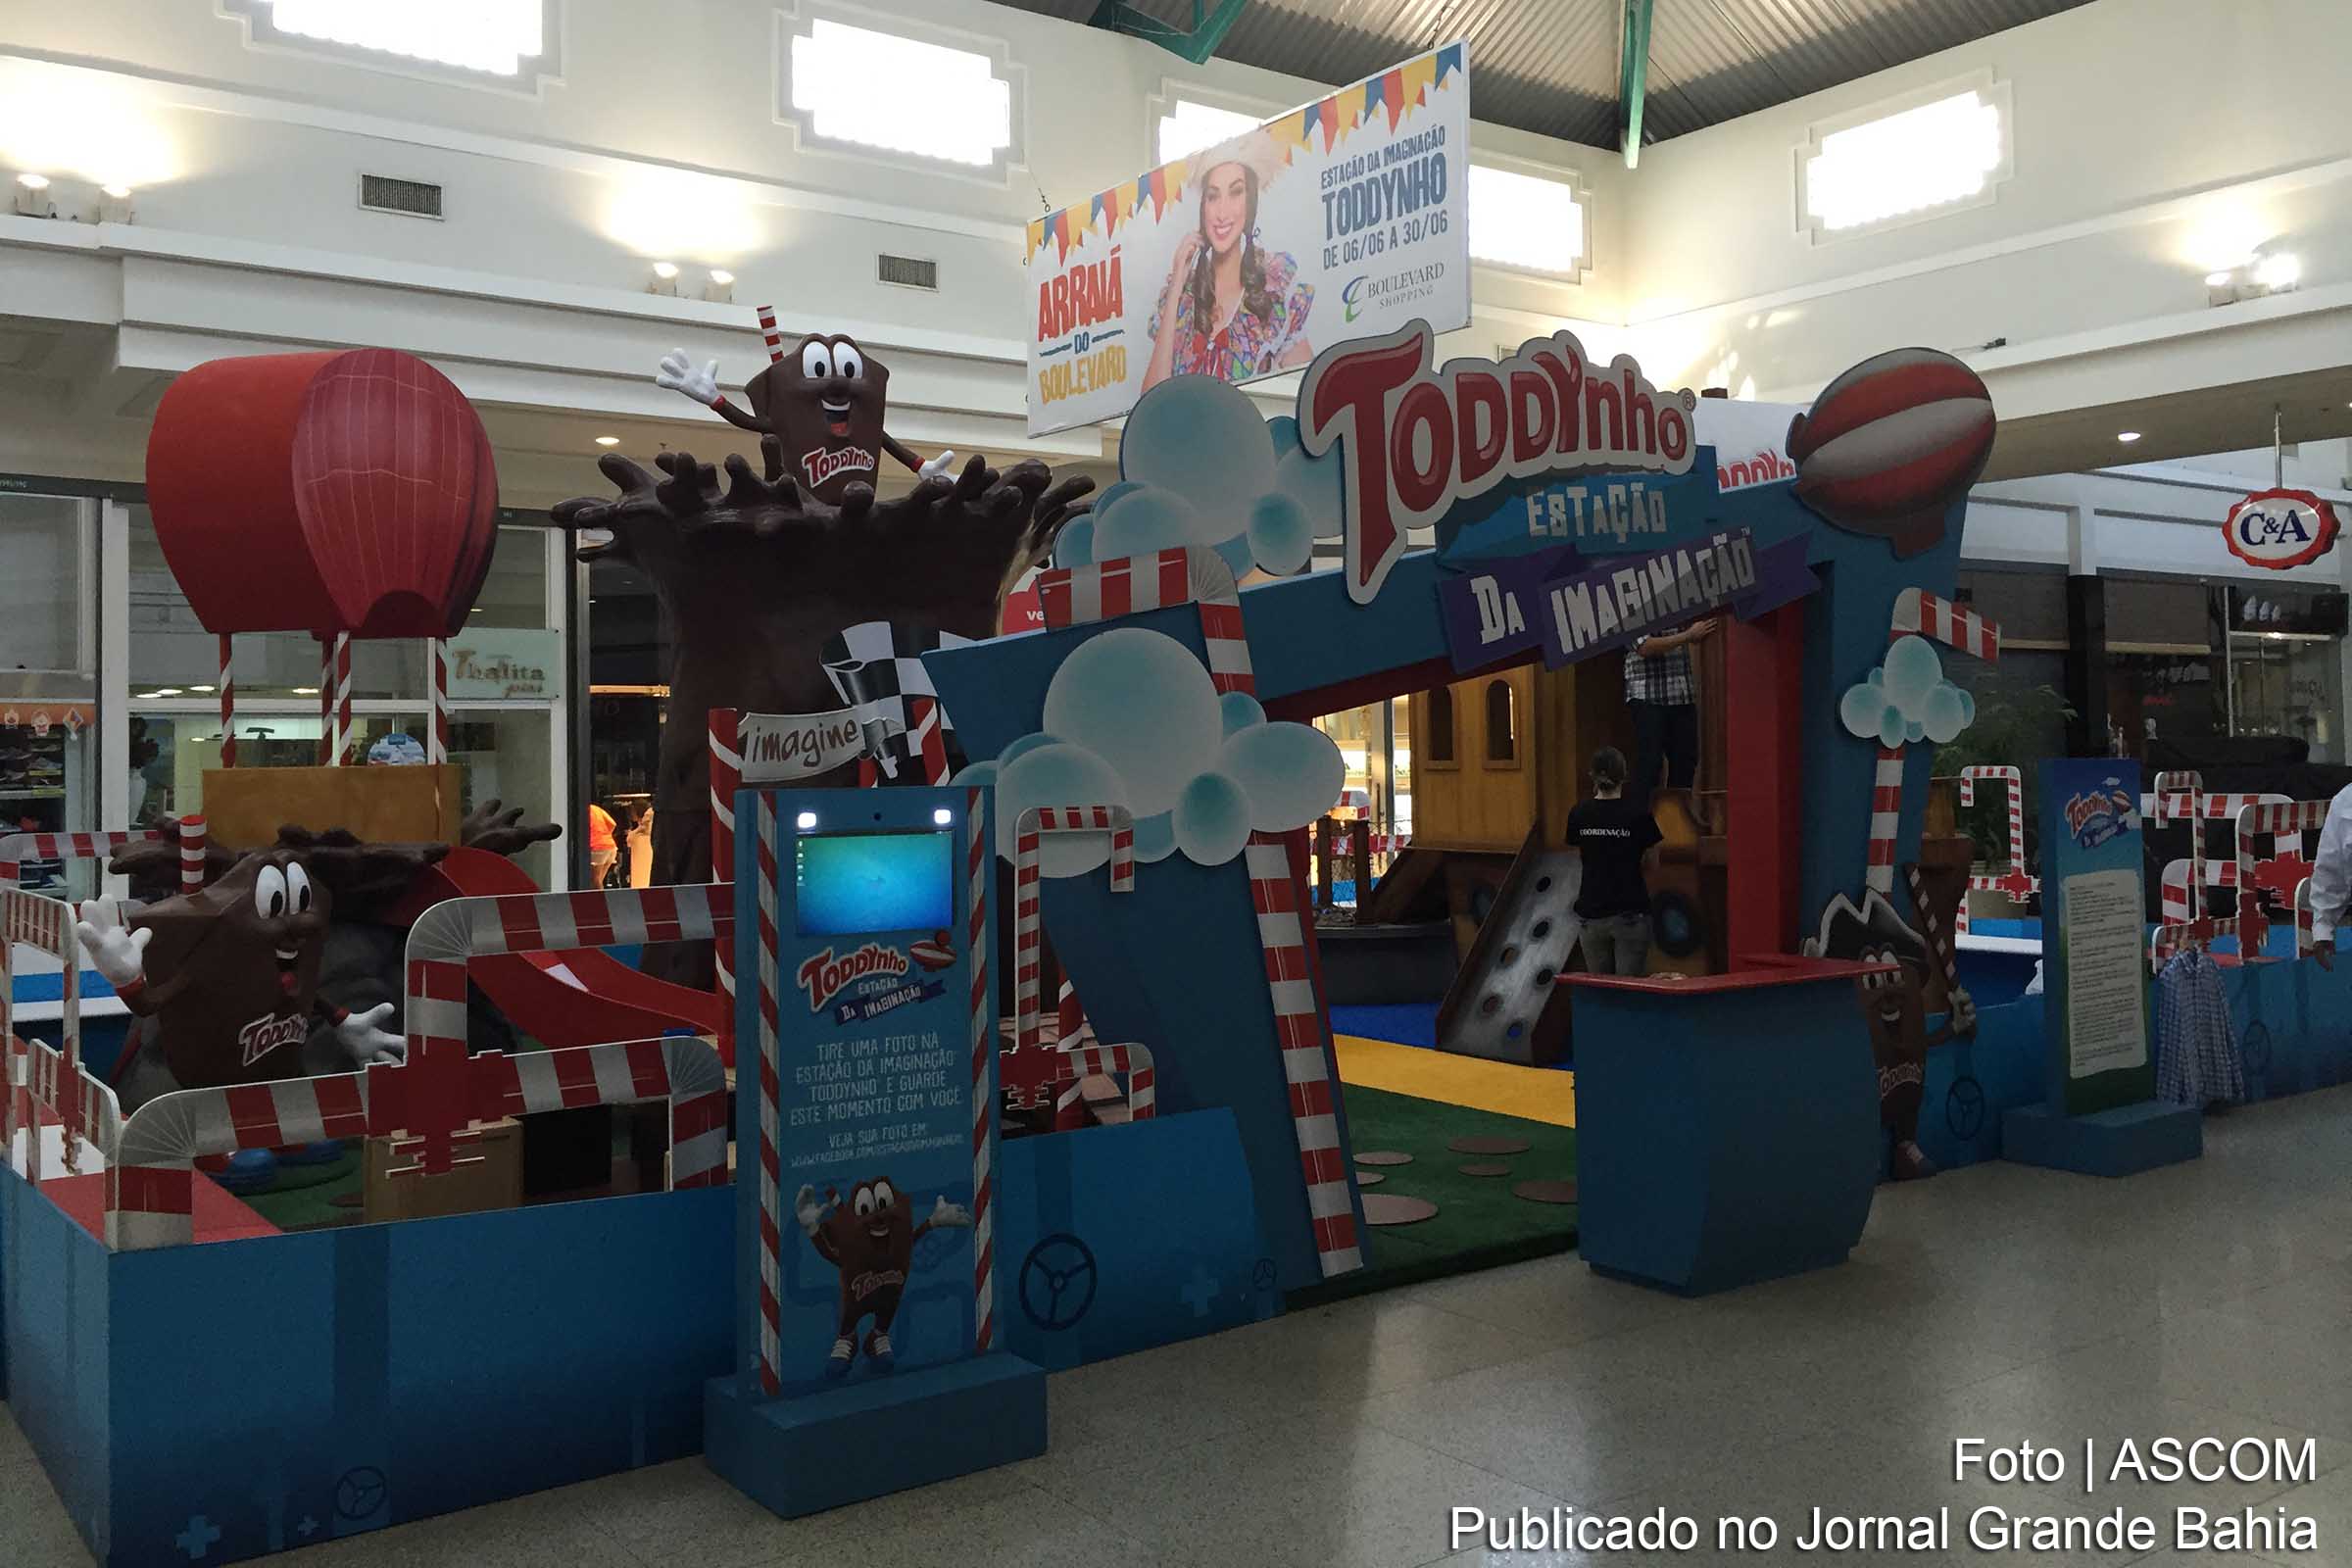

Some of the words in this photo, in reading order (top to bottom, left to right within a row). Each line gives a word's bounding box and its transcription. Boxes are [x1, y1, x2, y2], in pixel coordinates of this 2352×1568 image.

[1321, 155, 1364, 190] ESTAÇÃO
[1367, 150, 1381, 171] DA
[1322, 152, 1446, 241] TODDYNHO
[1323, 245, 1339, 270] DE
[1344, 230, 1385, 264] 06/06
[1390, 225, 1398, 249] A
[1402, 210, 1448, 245] 30/06
[1038, 244, 1123, 342] ARRAIÁ
[1368, 262, 1445, 299] BOULEVARD
[1379, 285, 1434, 310] SHOPPING
[1074, 331, 1090, 354] DO
[1039, 344, 1126, 405] BOULEVARD
[1526, 481, 1667, 544] ESTAÇÃO
[2240, 509, 2311, 546] C&A
[752, 719, 859, 767] imagine
[816, 1043, 845, 1061] TIRE
[851, 1040, 879, 1057] UMA
[885, 1034, 916, 1053] FOTO
[921, 1031, 940, 1050] NA
[796, 1061, 852, 1084] ESTAÇÃO
[858, 1061, 874, 1077] DA
[880, 1049, 955, 1074] IMAGINAÇÃO
[808, 1079, 877, 1102] TODDYNHO
[886, 1077, 894, 1093] E
[900, 1070, 947, 1092] GUARDE
[791, 1108, 821, 1126] ESTE
[827, 1097, 892, 1121] MOMENTO
[897, 1094, 924, 1112] COM
[828, 1133, 854, 1149] VEJA
[858, 1129, 879, 1144] SUA
[882, 1125, 907, 1141] FOTO
